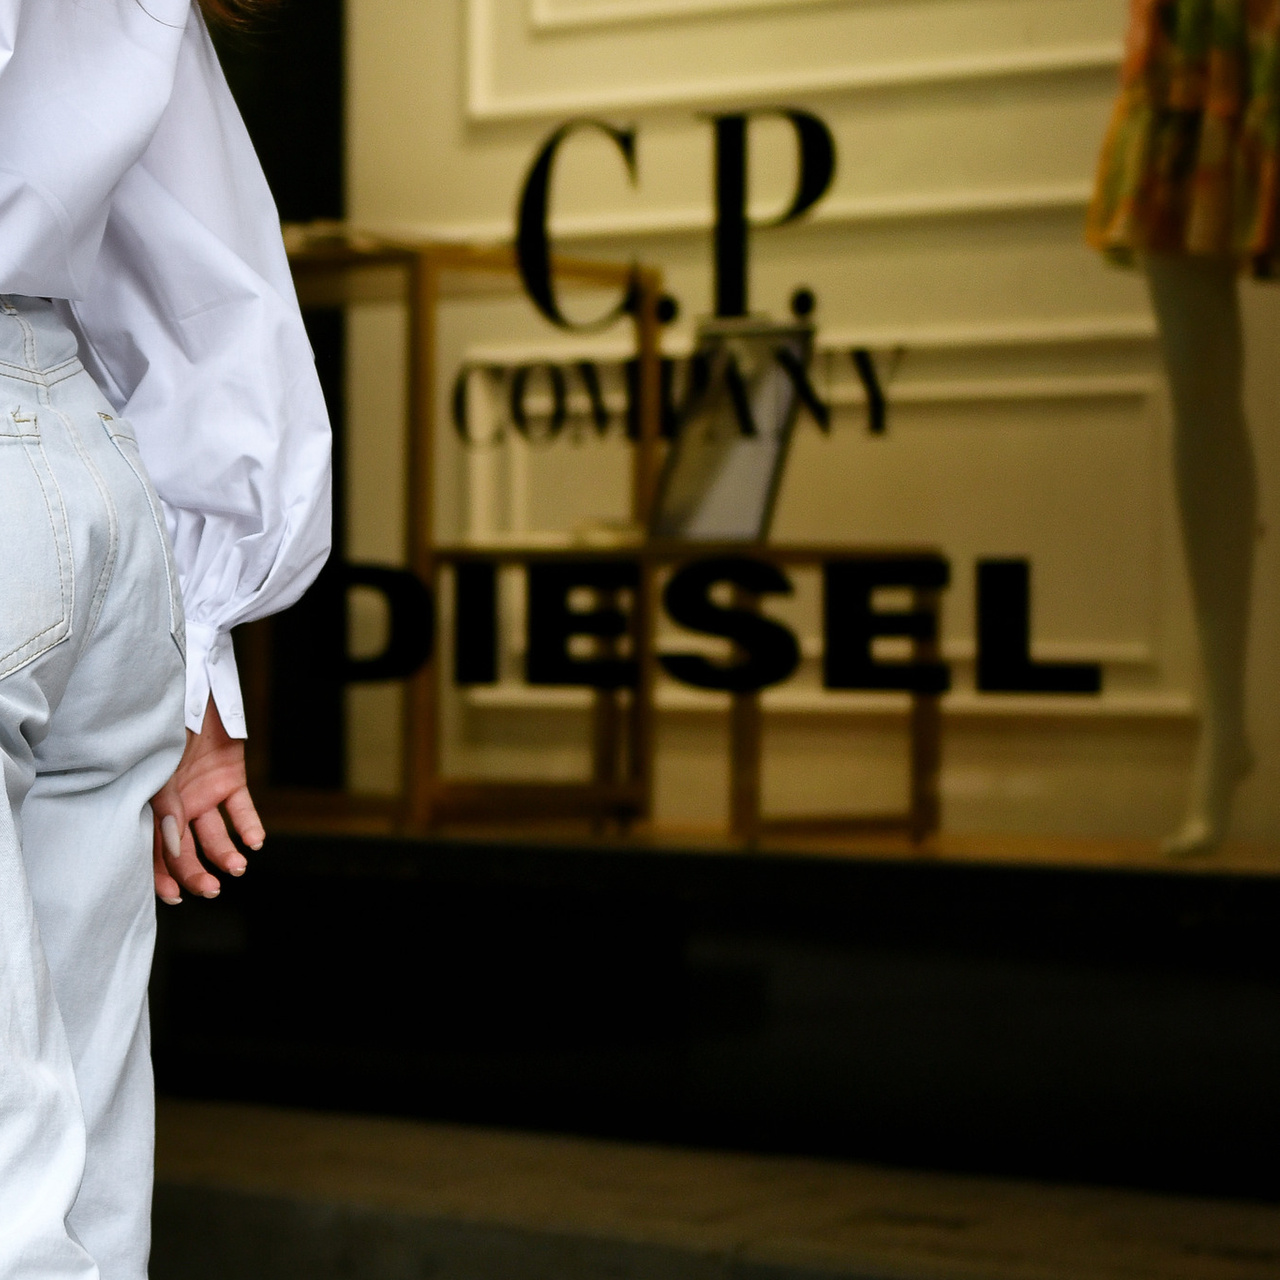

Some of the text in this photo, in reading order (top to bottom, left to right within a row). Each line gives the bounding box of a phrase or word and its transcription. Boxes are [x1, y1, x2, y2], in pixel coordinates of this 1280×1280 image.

[514, 107, 838, 334] C.P.
[452, 344, 906, 446] COMPANY
[310, 557, 1103, 694] DIESEL
